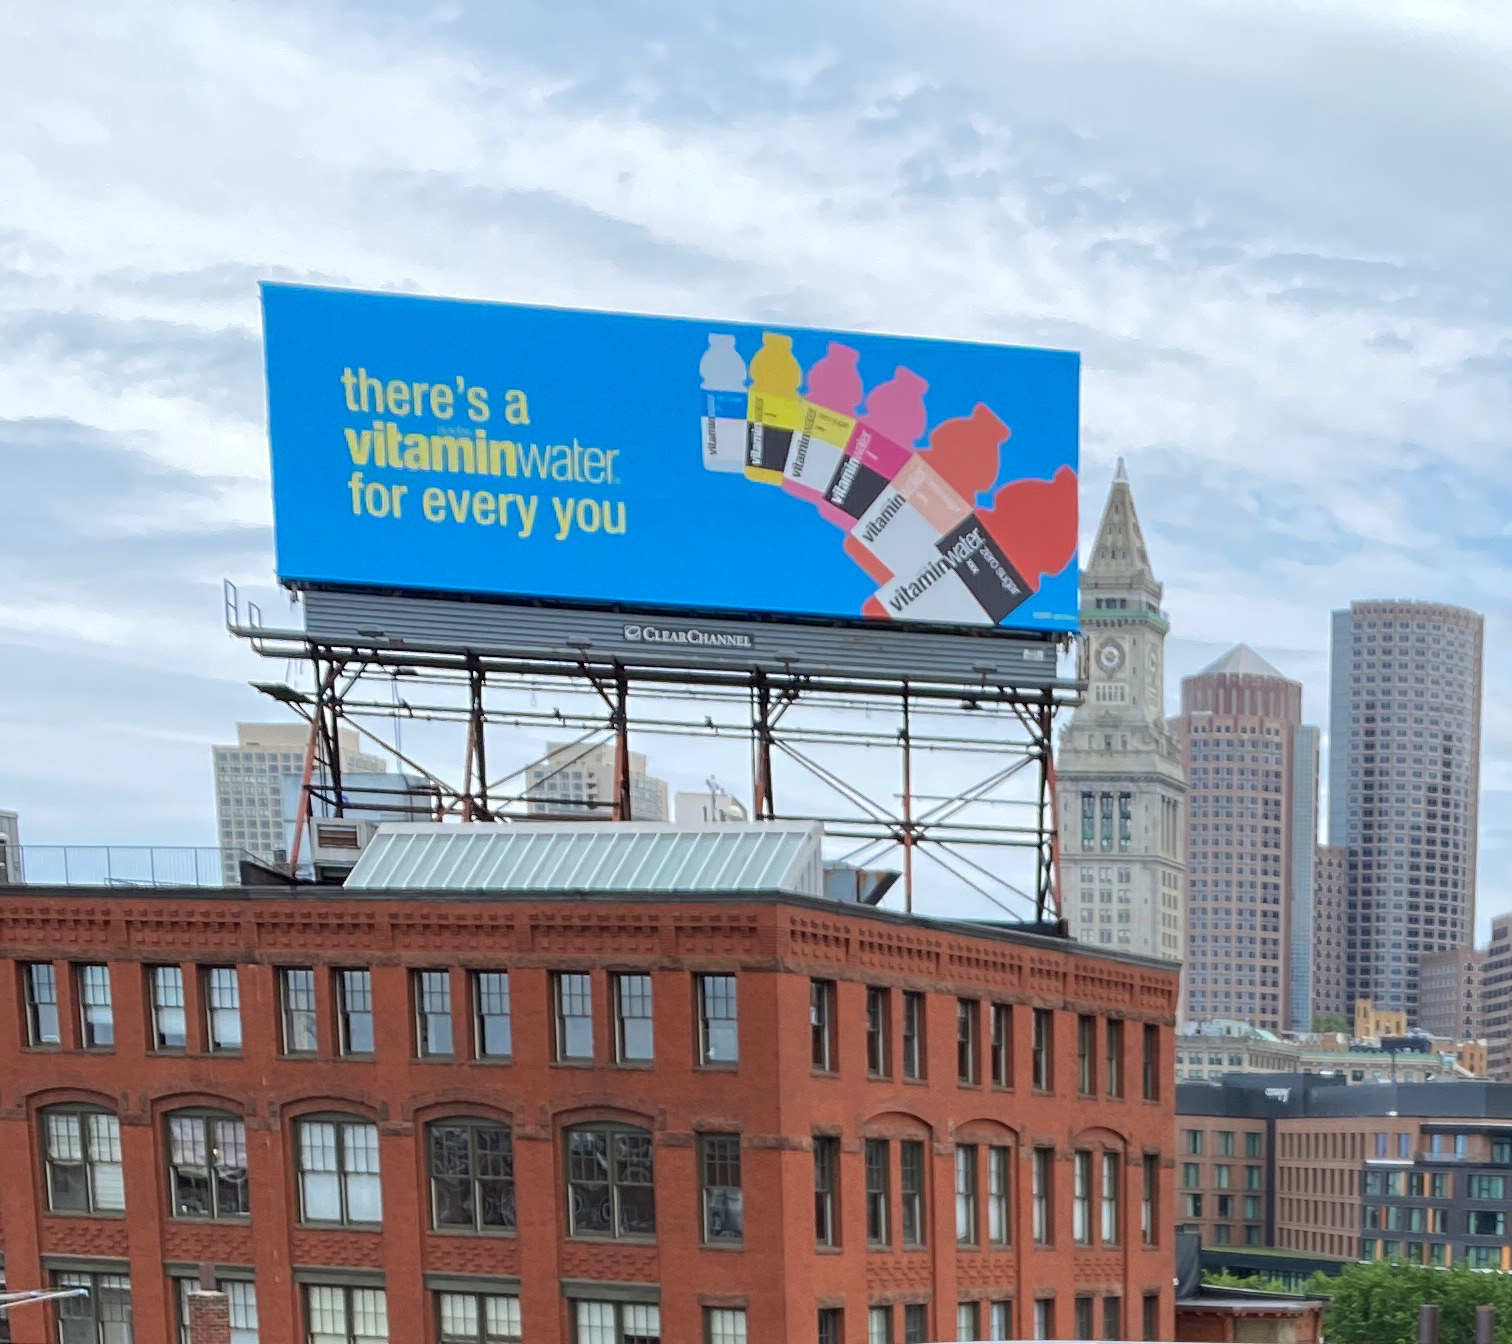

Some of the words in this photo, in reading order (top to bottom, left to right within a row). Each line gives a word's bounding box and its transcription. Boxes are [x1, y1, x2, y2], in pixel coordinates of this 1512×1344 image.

[340, 366, 491, 423] there's
[504, 389, 531, 425] a
[344, 419, 621, 484] vitaminwater
[348, 471, 408, 519] for
[422, 486, 539, 539] every
[552, 496, 627, 541] you
[888, 526, 984, 613] vitaminwater
